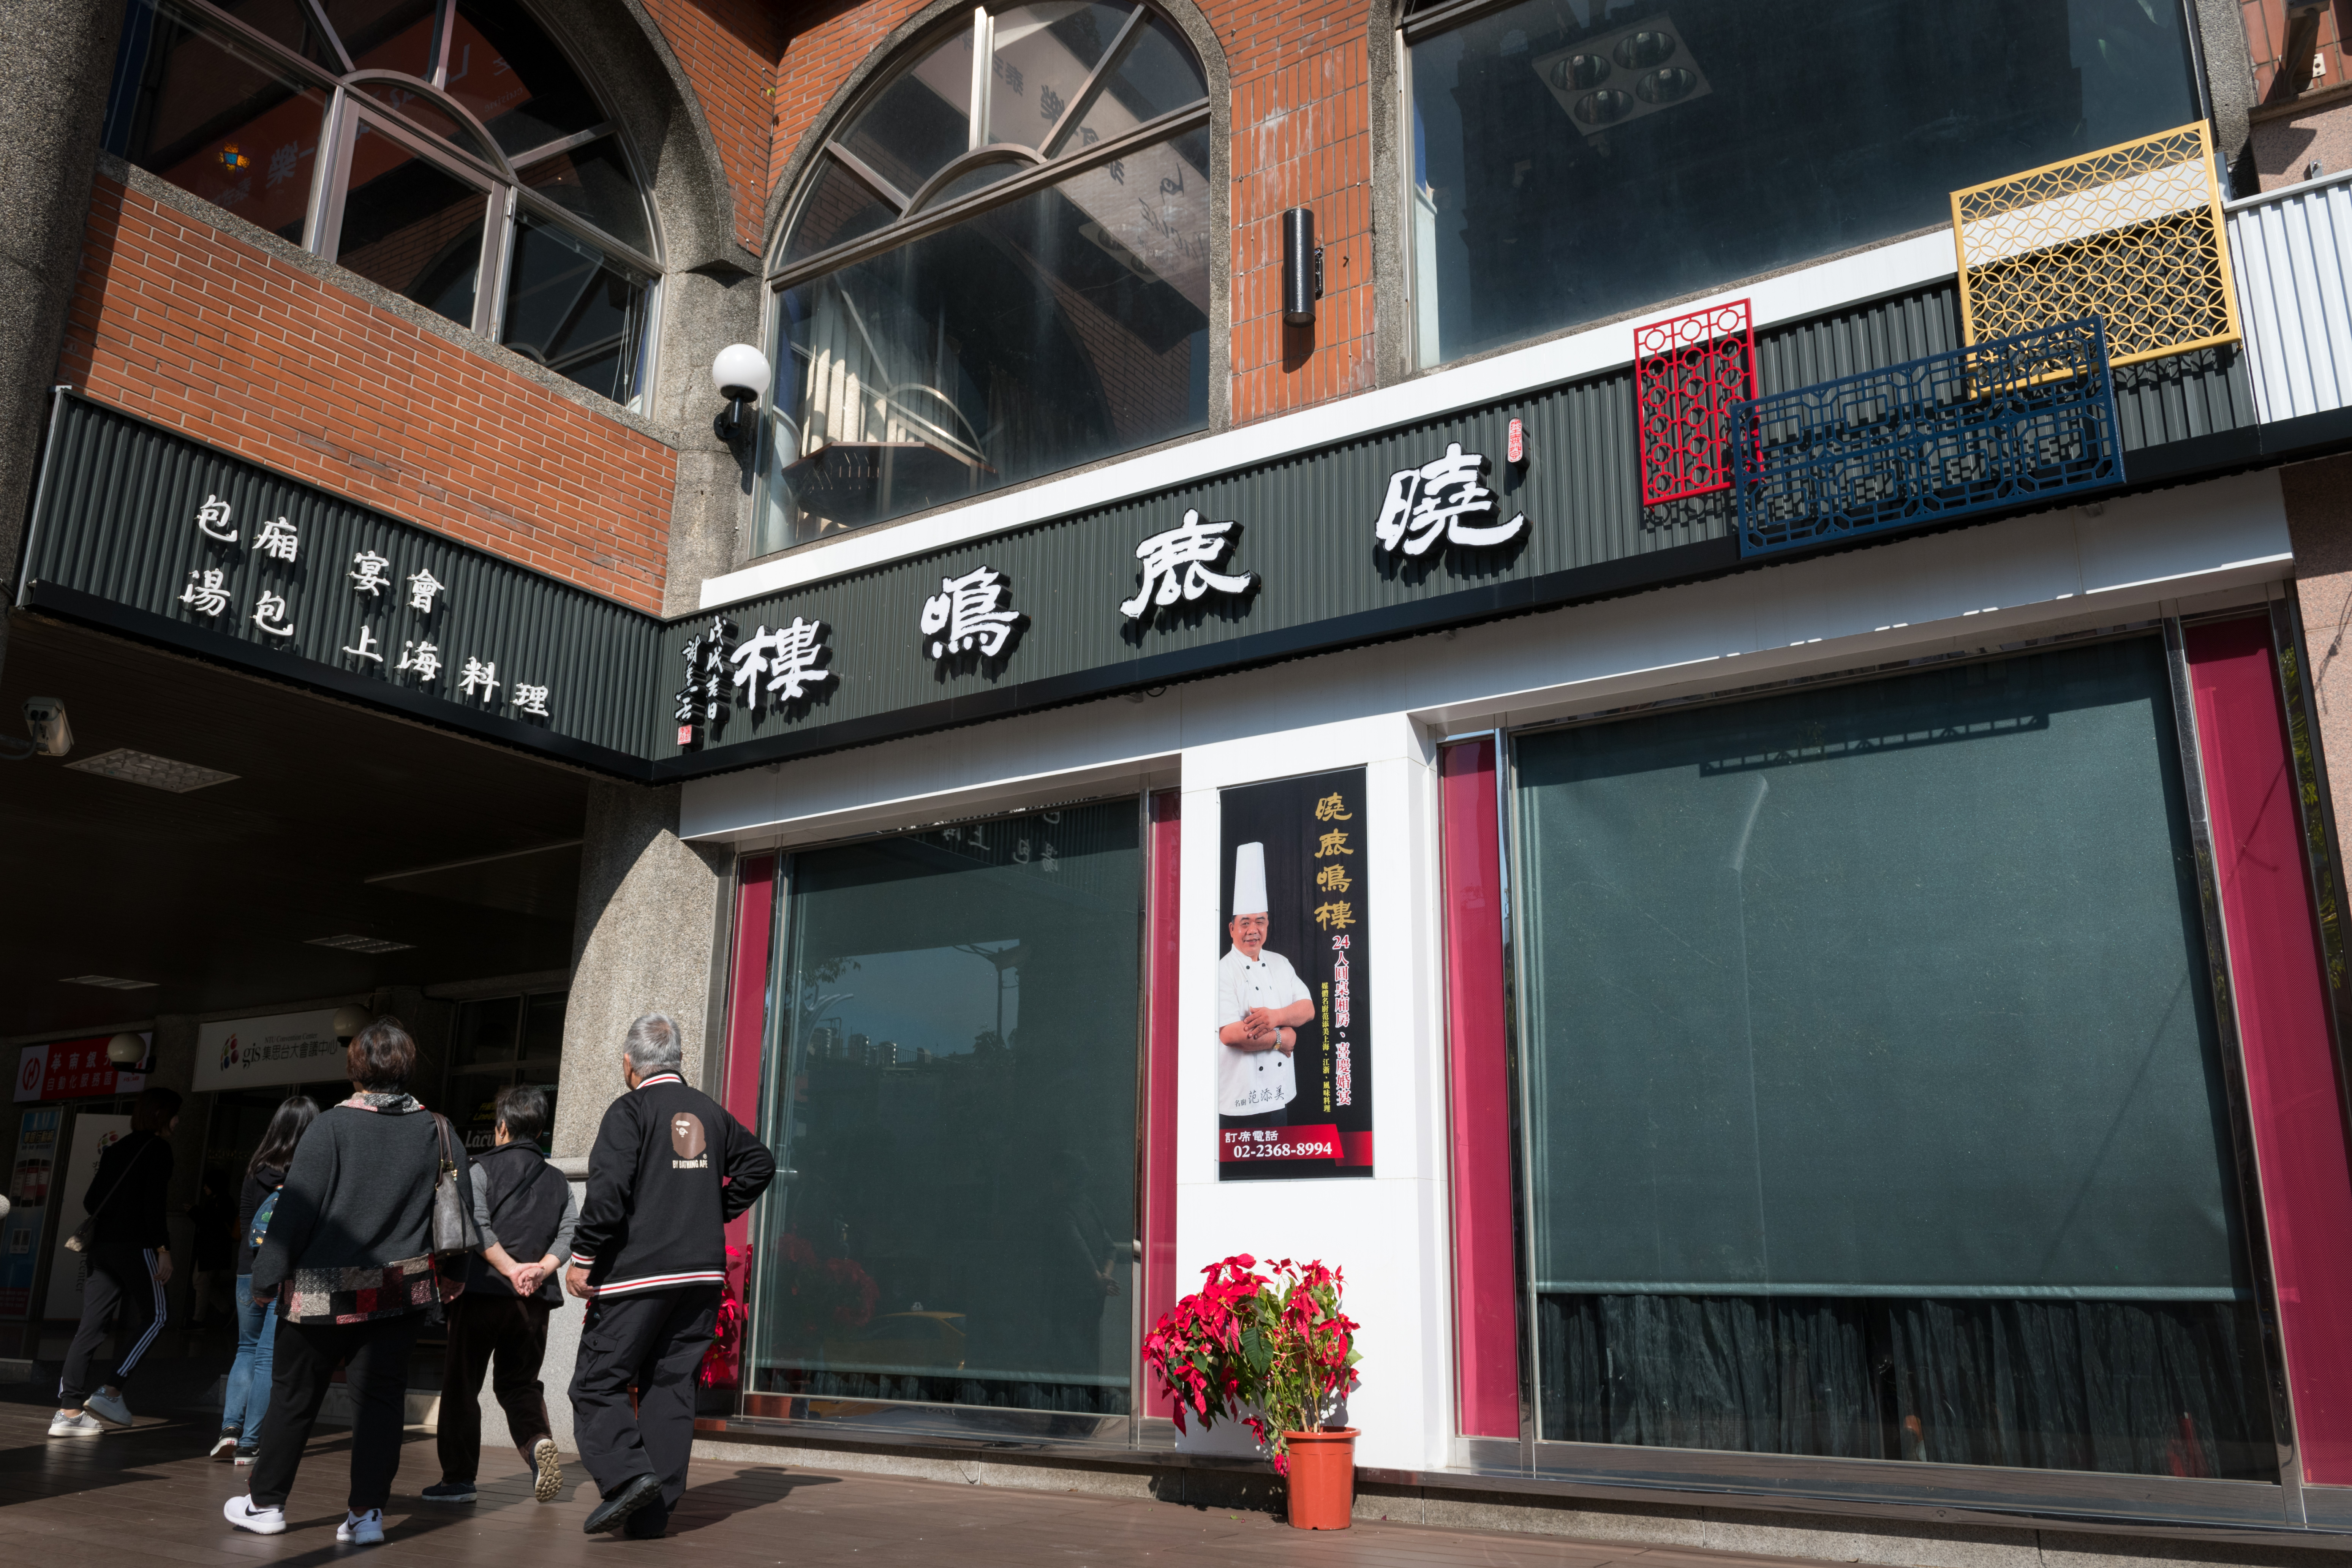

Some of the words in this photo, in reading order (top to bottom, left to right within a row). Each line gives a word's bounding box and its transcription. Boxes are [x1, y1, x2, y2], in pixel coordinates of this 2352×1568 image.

[194, 494, 299, 563] 包廂
[347, 550, 445, 613] 宴會
[177, 569, 294, 636] 湯包
[342, 625, 549, 716] 上海料理
[1314, 792, 1356, 931] 曉鹿鳴樓
[276, 1034, 301, 1043] Convention
[243, 1043, 260, 1070] gis
[262, 1038, 338, 1061] 集思台大會議中心
[46, 1070, 114, 1091] 自動化服務區
[1225, 1130, 1279, 1143] 訂席電話
[1234, 1142, 1332, 1158] 02-2368-8994
[673, 1160, 678, 1169] BY
[679, 1160, 699, 1169] BATHING
[699, 1160, 708, 1168] APE
